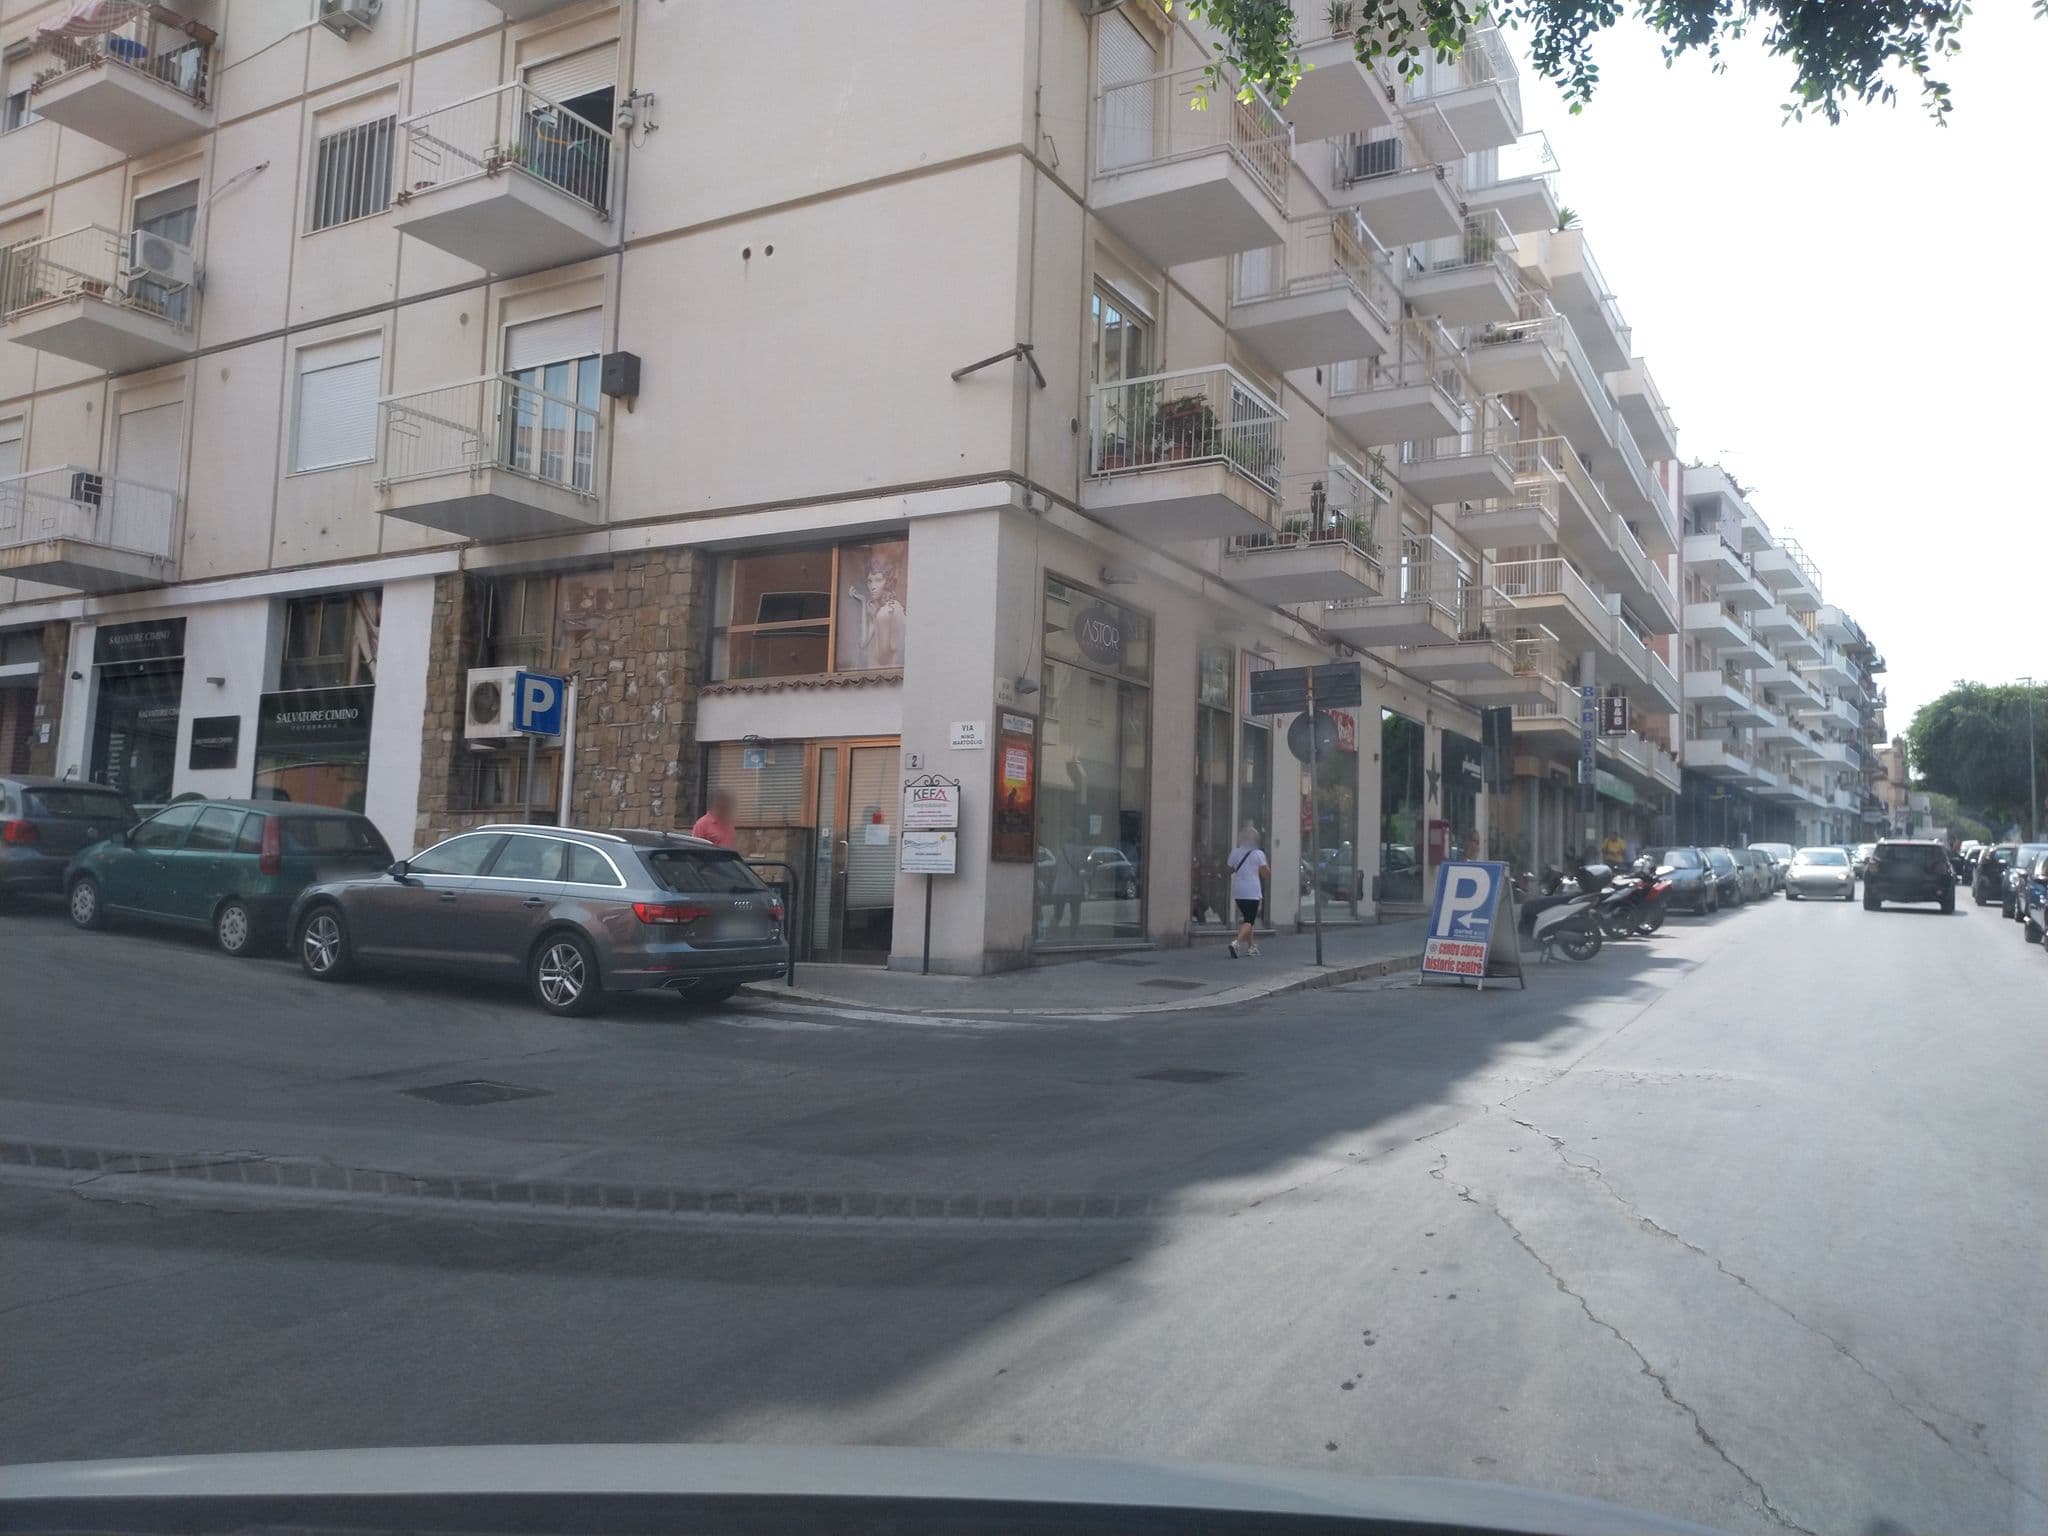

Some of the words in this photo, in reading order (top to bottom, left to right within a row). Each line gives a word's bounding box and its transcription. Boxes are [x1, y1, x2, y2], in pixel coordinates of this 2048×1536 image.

[1082, 618, 1120, 650] ASTOR
[522, 678, 555, 727] P
[276, 711, 325, 723] SALVATORE
[325, 708, 359, 721] CIMINO
[961, 724, 974, 732] VIA
[911, 755, 918, 768] 2
[1436, 866, 1491, 937] P
[1438, 942, 1460, 956] centro
[1460, 943, 1484, 958] storico
[1425, 956, 1455, 971] historic
[1456, 959, 1482, 975] centre
